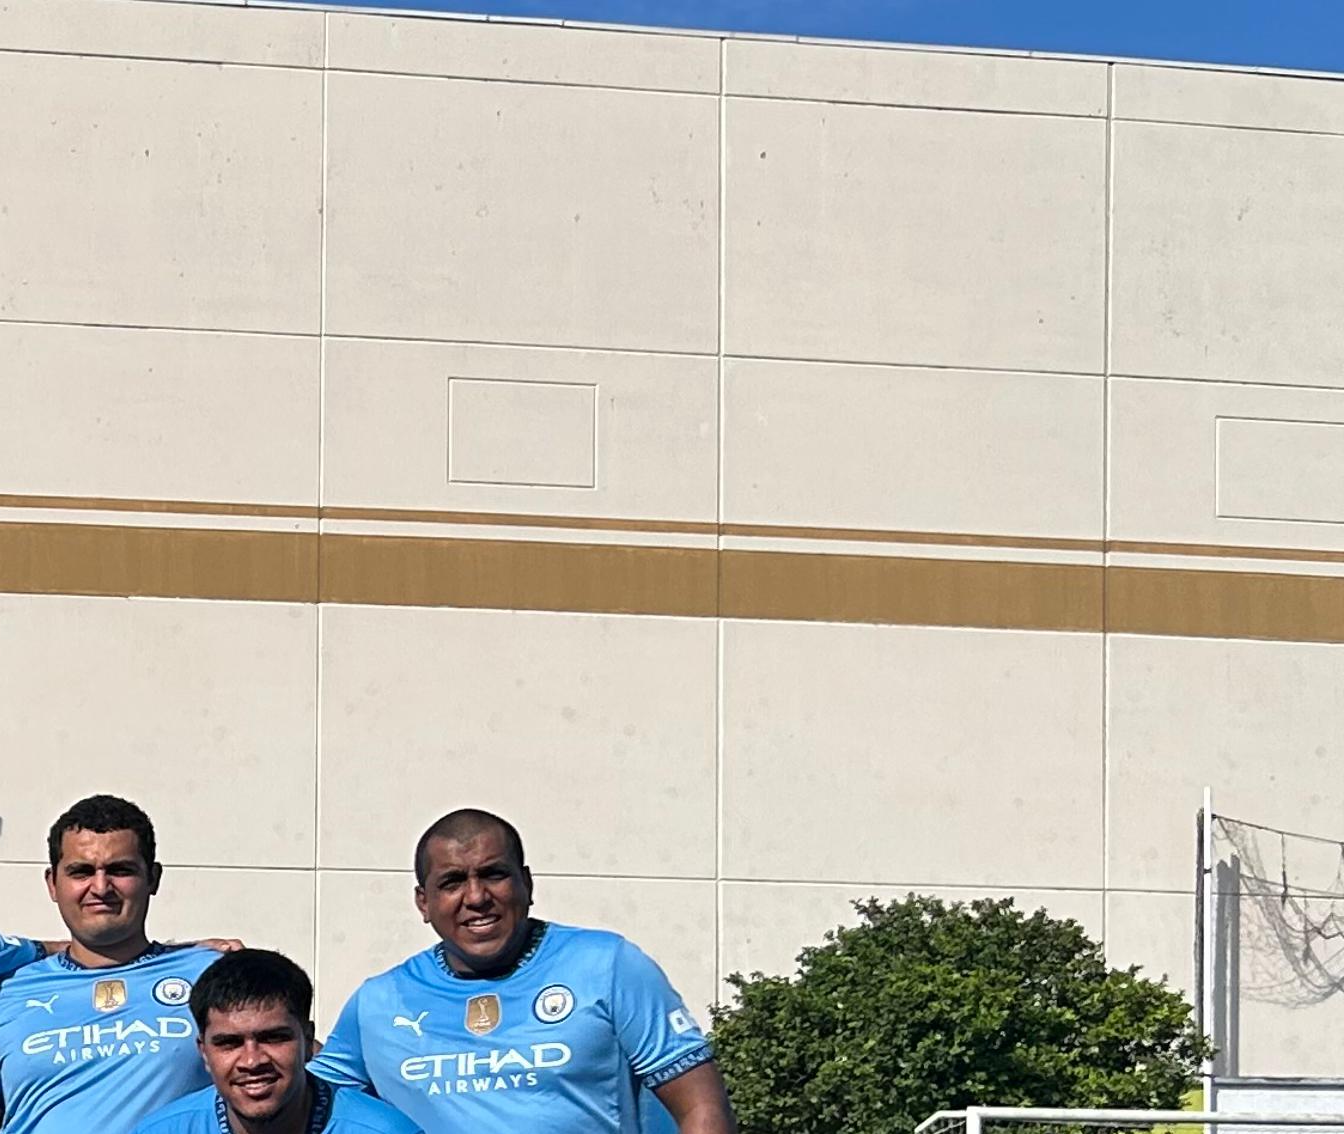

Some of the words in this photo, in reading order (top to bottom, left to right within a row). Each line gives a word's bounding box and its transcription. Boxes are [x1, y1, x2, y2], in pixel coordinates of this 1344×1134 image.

[22, 1017, 193, 1055] ETIHAD
[53, 1040, 161, 1065] AIRWAYS
[400, 1042, 572, 1081] ETIHAD
[428, 1072, 539, 1096] AIRWAYS
